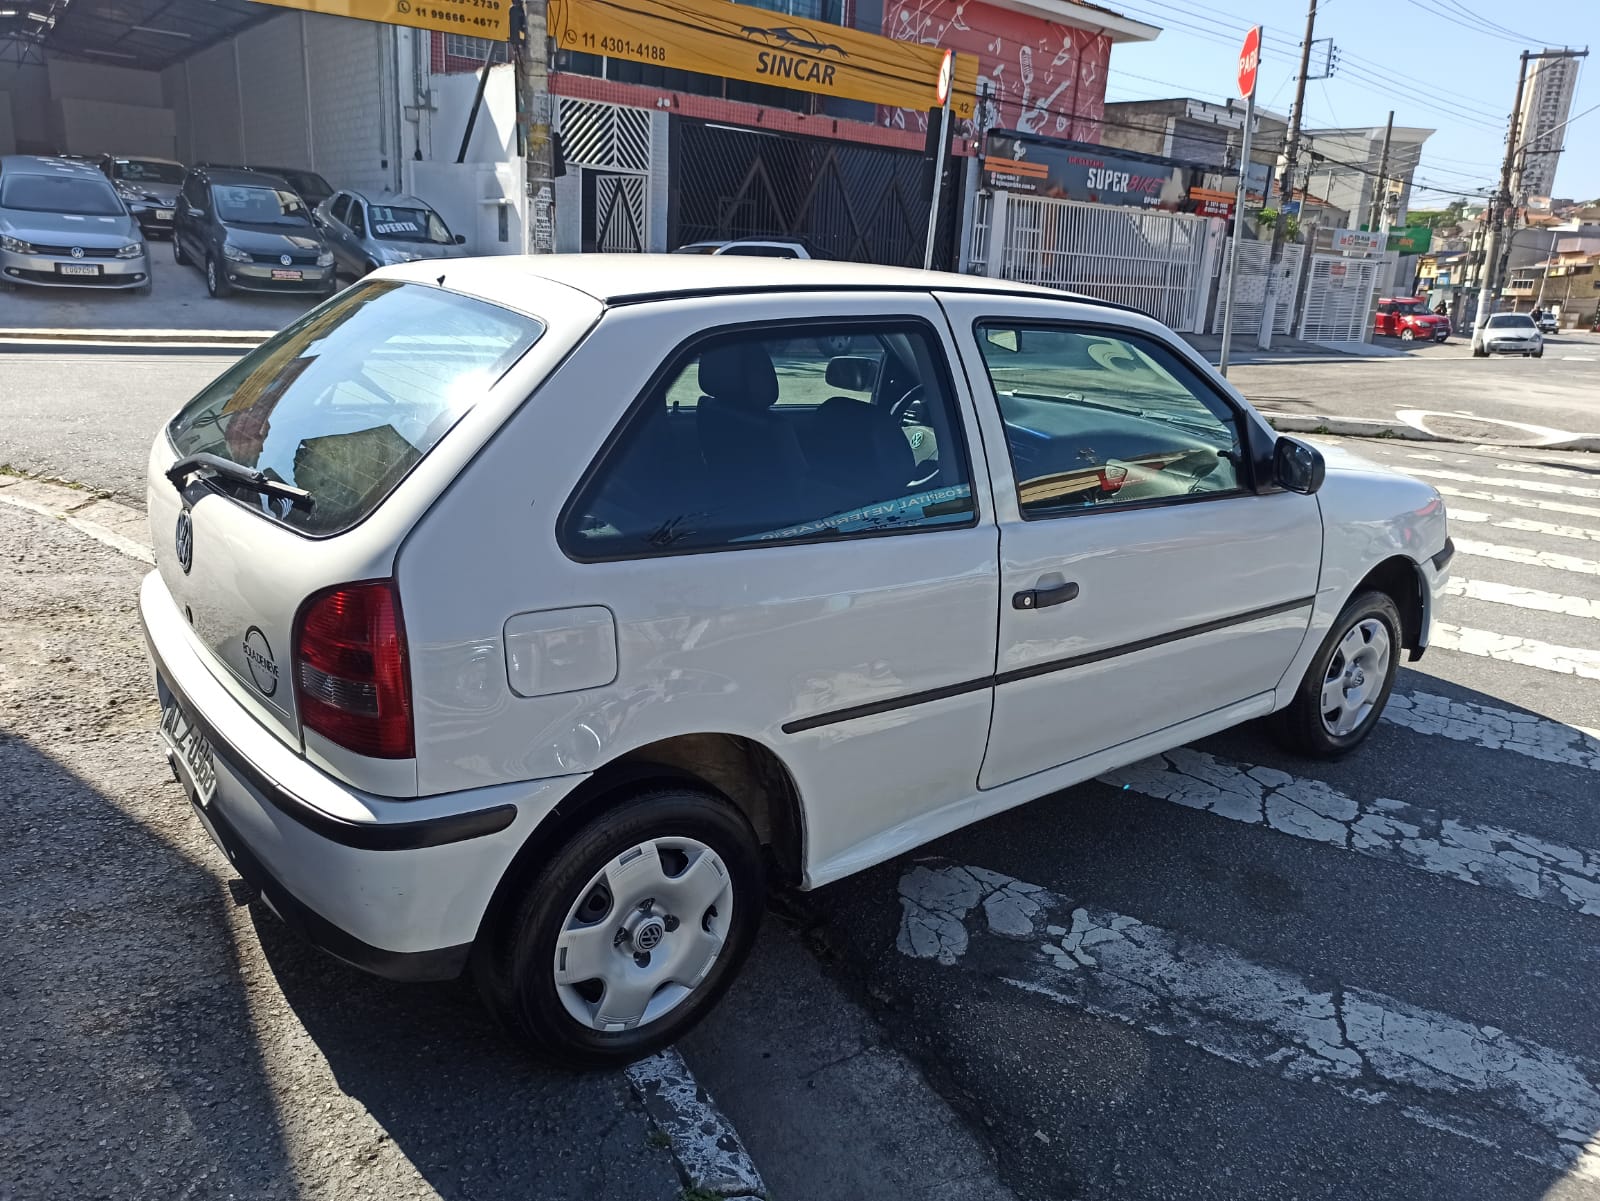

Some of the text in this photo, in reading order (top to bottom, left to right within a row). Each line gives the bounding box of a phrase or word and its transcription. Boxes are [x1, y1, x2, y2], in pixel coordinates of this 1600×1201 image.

[416, 8, 500, 28] 11 99666-4677
[583, 32, 666, 61] 11 4301-4188
[756, 51, 836, 86] SINCAR
[960, 102, 969, 113] 42
[376, 222, 418, 233] OFERTA
